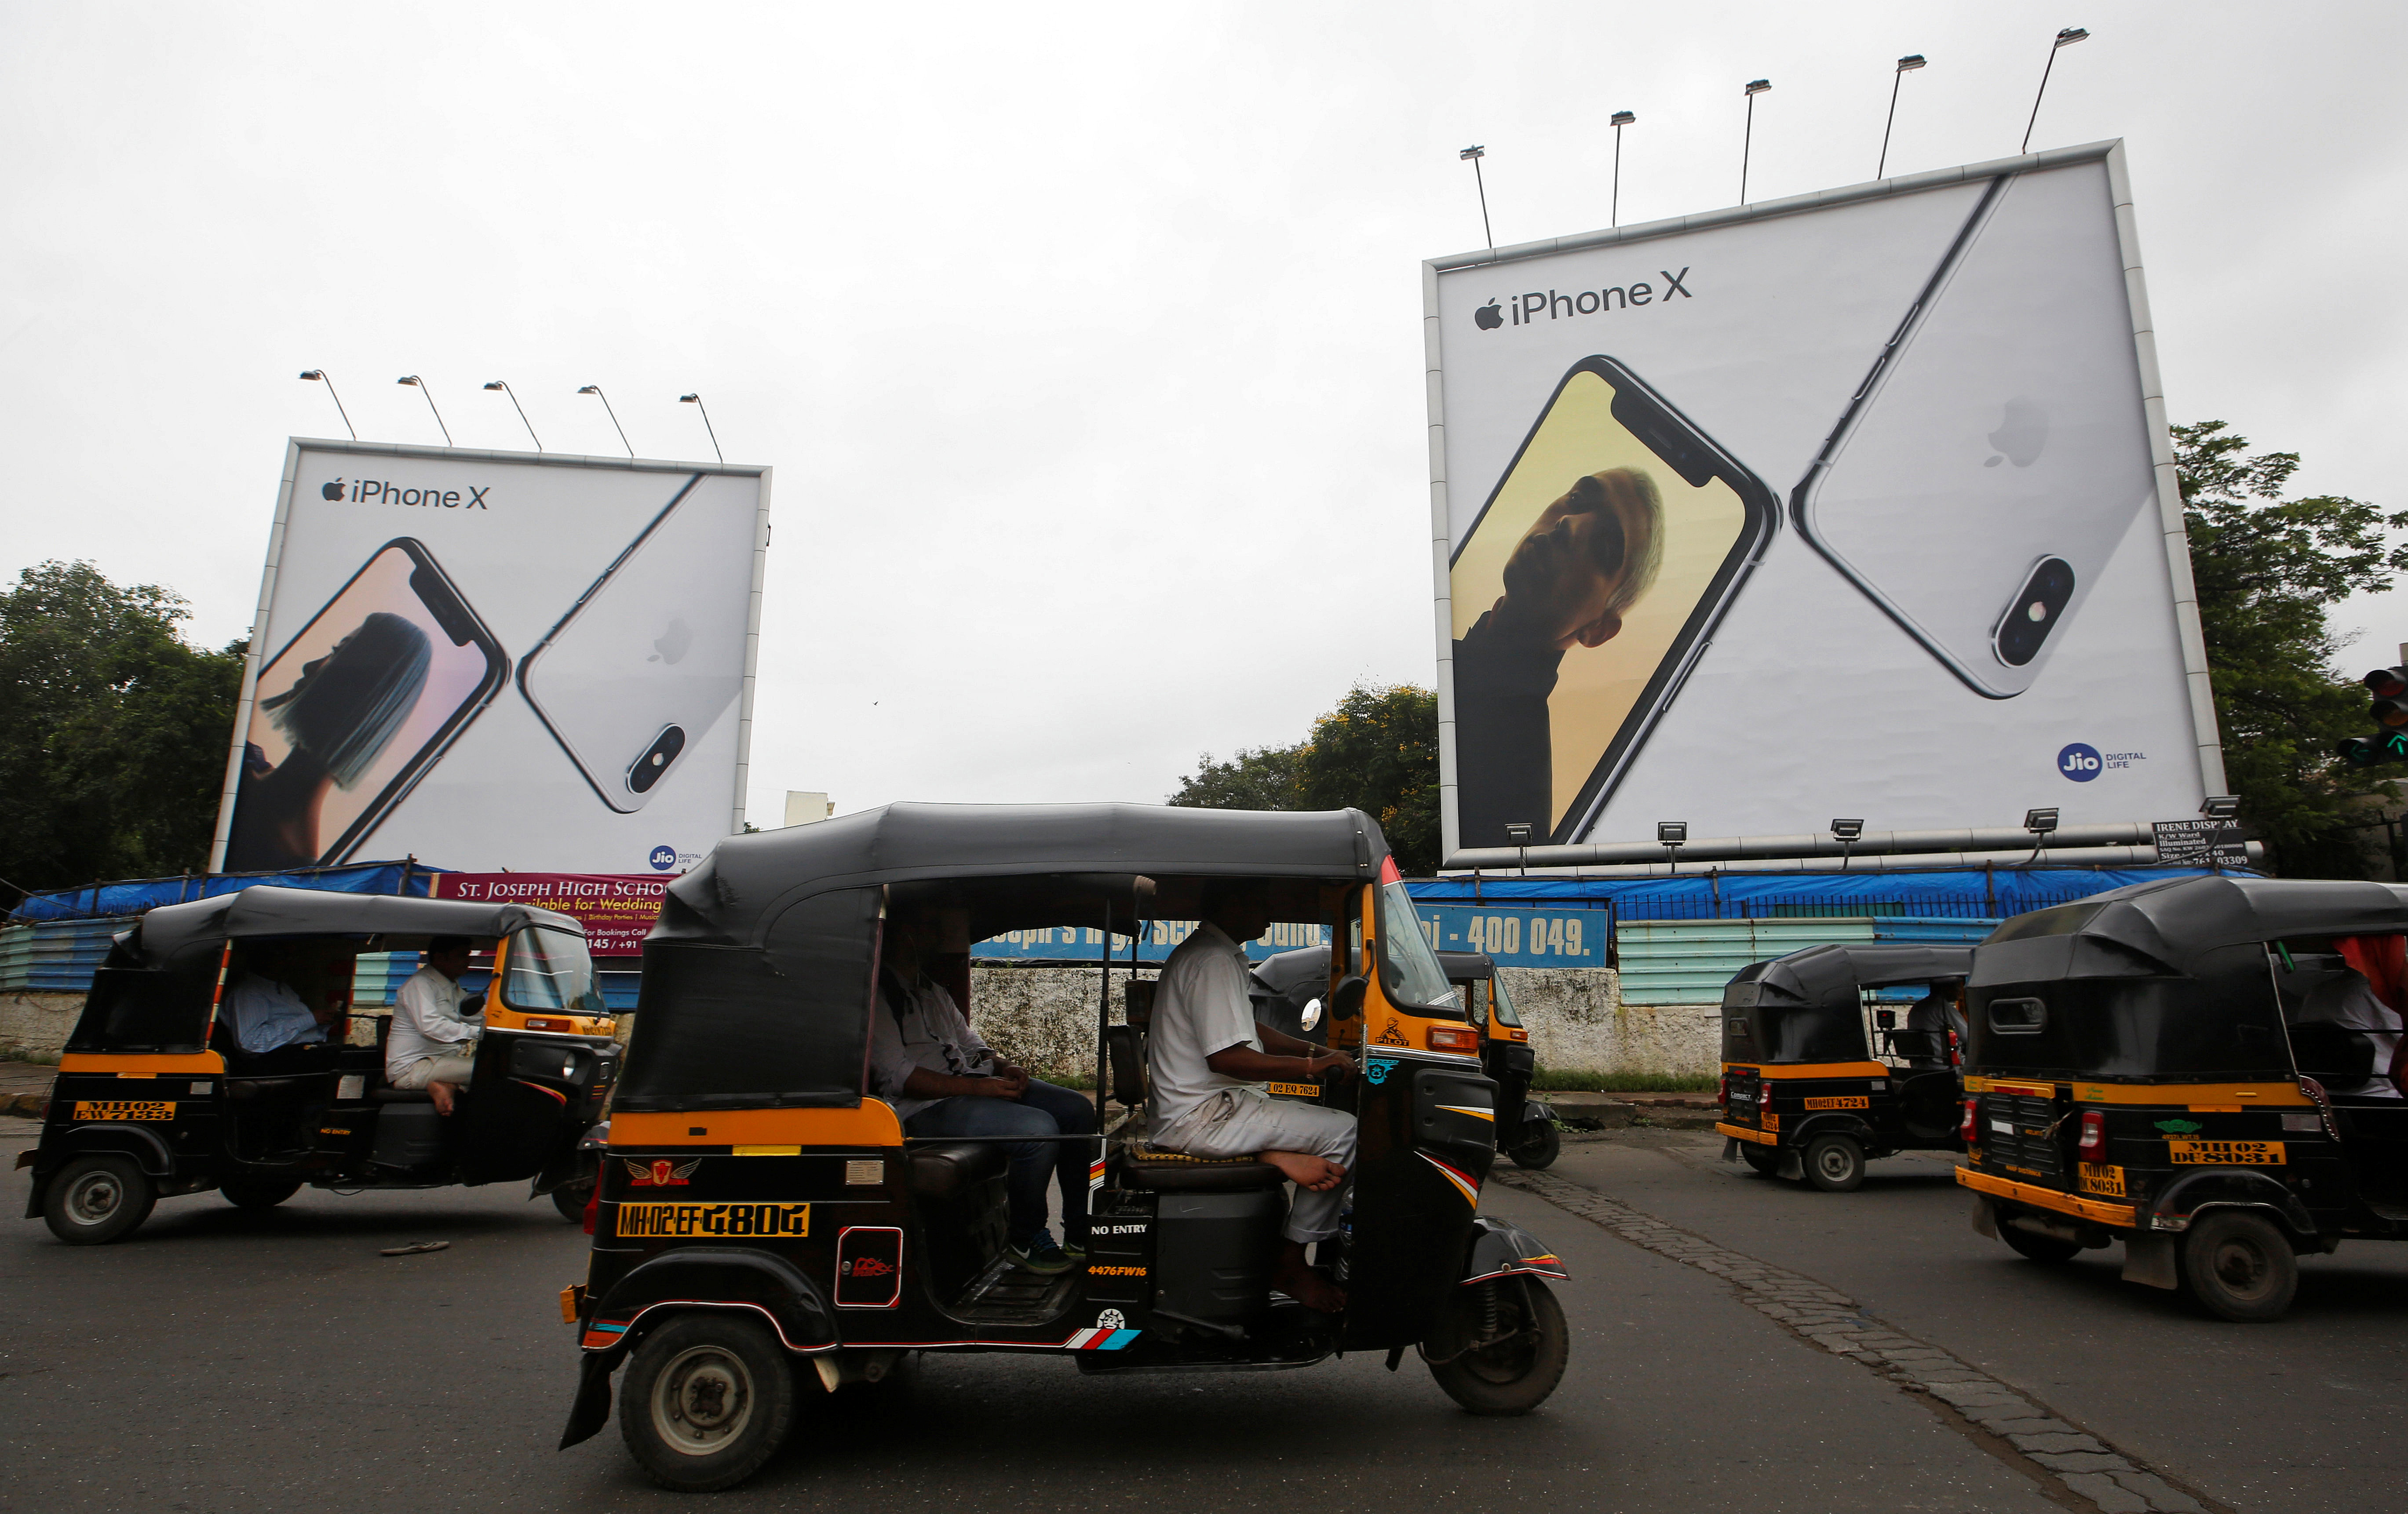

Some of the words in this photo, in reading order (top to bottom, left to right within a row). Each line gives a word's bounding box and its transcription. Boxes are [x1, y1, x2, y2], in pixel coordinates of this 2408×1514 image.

[1511, 282, 1653, 325] iPhone
[1660, 266, 1693, 302] X
[352, 479, 460, 508] iPhone
[465, 486, 491, 510] X
[2063, 752, 2099, 771] Jio
[2106, 753, 2147, 761] DIGITAL
[2156, 823, 2190, 832] IRENE
[2159, 837, 2206, 847] Illuminated
[652, 851, 674, 863] Jio
[613, 881, 667, 896] SCHO
[575, 897, 595, 910] for
[600, 897, 662, 913] Wedding
[597, 928, 630, 937] Bookings
[1467, 916, 1520, 954] 400
[1530, 917, 1590, 956] 049.
[1376, 1037, 1408, 1046] PILOT
[1273, 1084, 1283, 1093] 02
[1285, 1085, 1297, 1094] EQ
[1299, 1085, 1318, 1095] 7624
[75, 1110, 174, 1120] EW7133
[2172, 1152, 2283, 1164] DU8031
[1091, 1226, 1109, 1234] NO
[1113, 1224, 1147, 1234] ENTRY
[1087, 1266, 1147, 1276] 4476FW16
